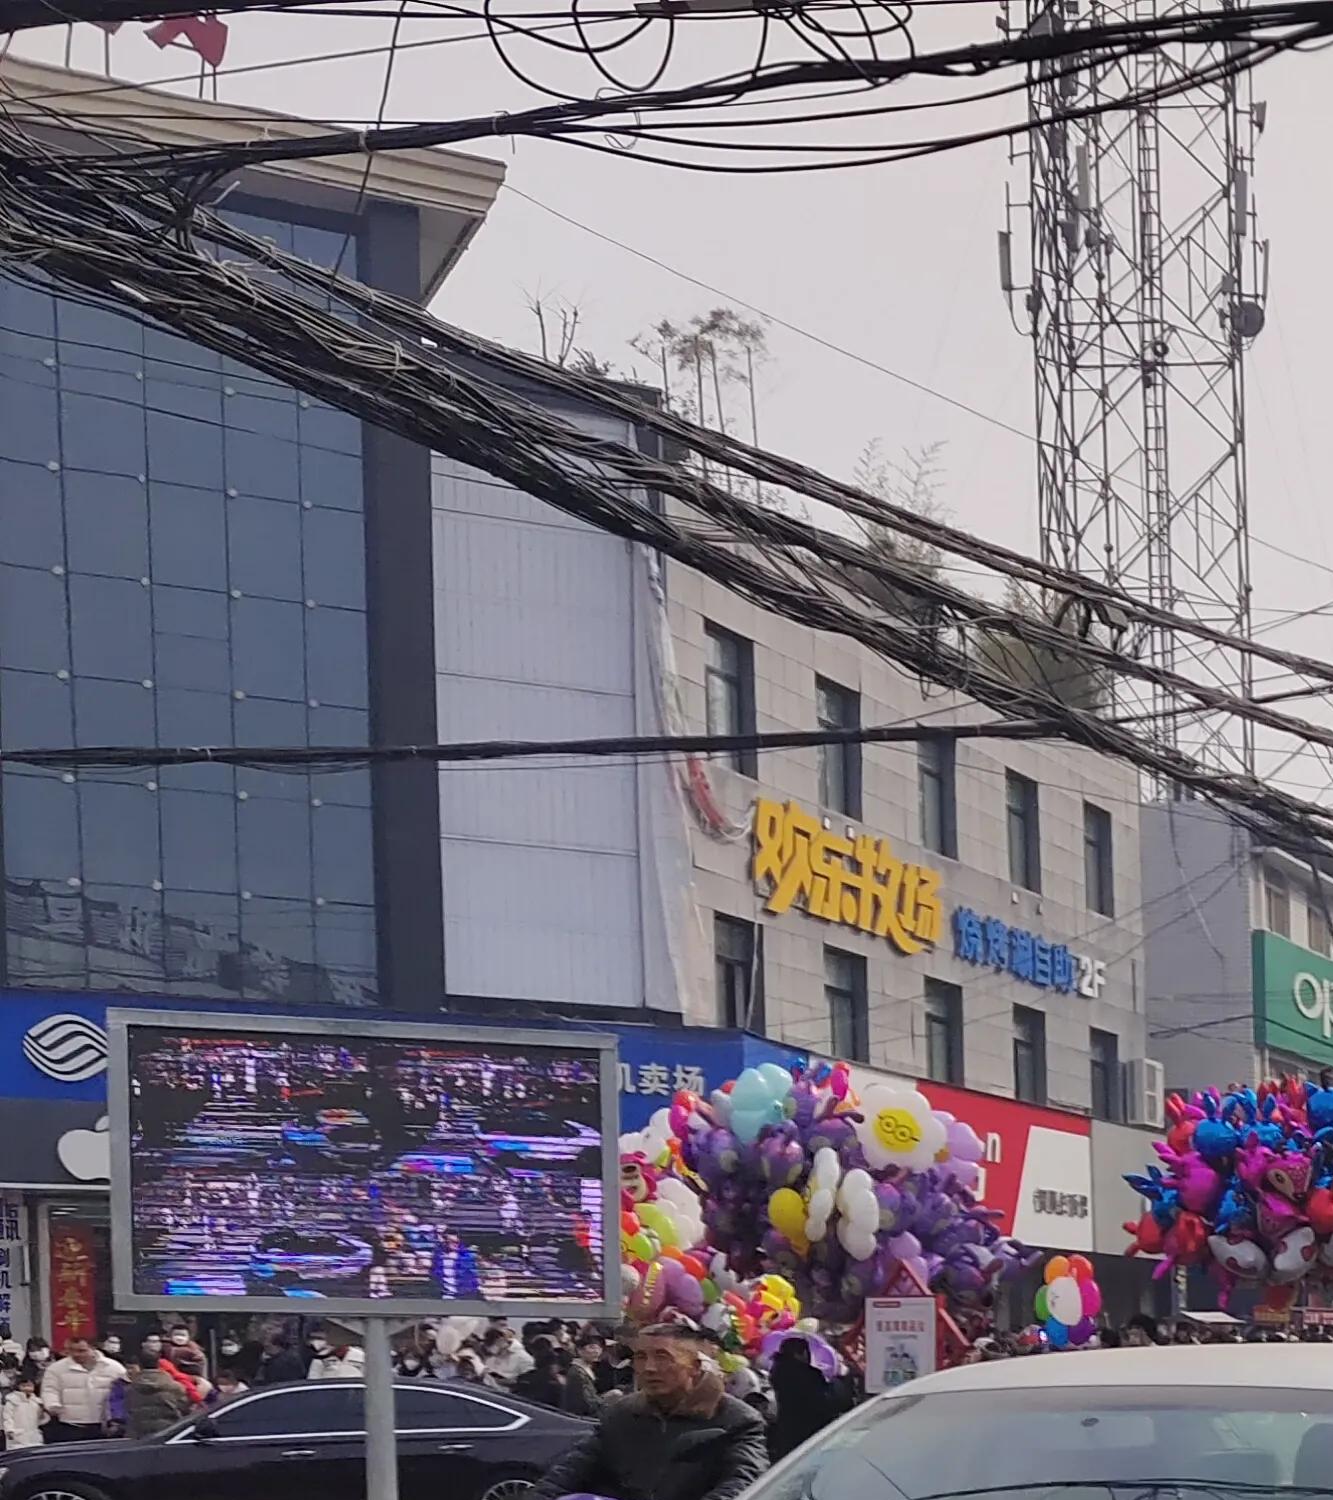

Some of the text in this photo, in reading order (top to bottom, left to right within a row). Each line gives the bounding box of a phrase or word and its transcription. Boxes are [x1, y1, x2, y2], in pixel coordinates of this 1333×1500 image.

[754, 796, 944, 955] 欢乐牧场
[1076, 954, 1106, 999] 2F
